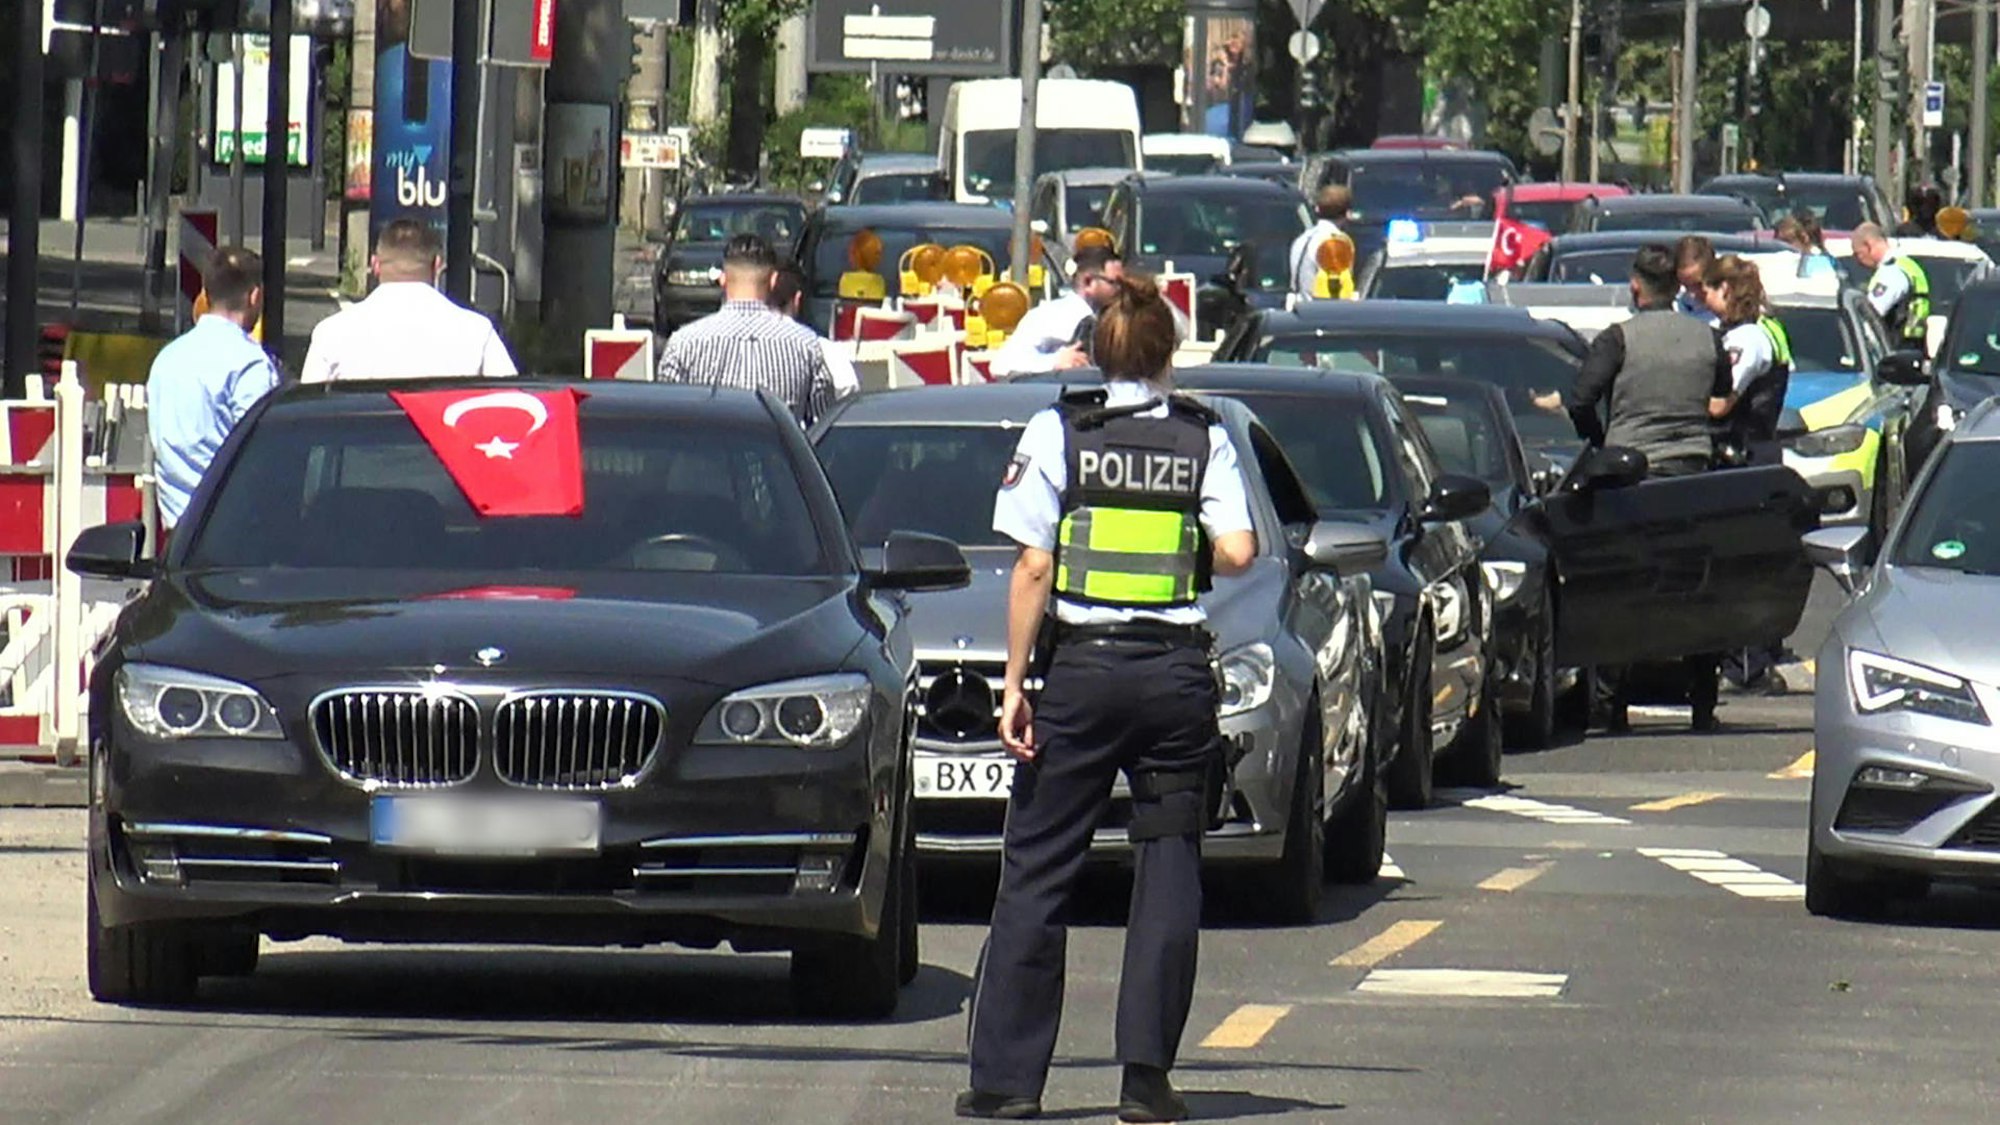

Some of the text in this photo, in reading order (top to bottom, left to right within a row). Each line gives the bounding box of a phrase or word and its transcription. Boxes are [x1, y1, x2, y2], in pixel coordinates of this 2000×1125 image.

[385, 151, 417, 178] my
[398, 165, 447, 207] blu
[1080, 450, 1198, 492] POLIZEI
[937, 762, 976, 792] BX
